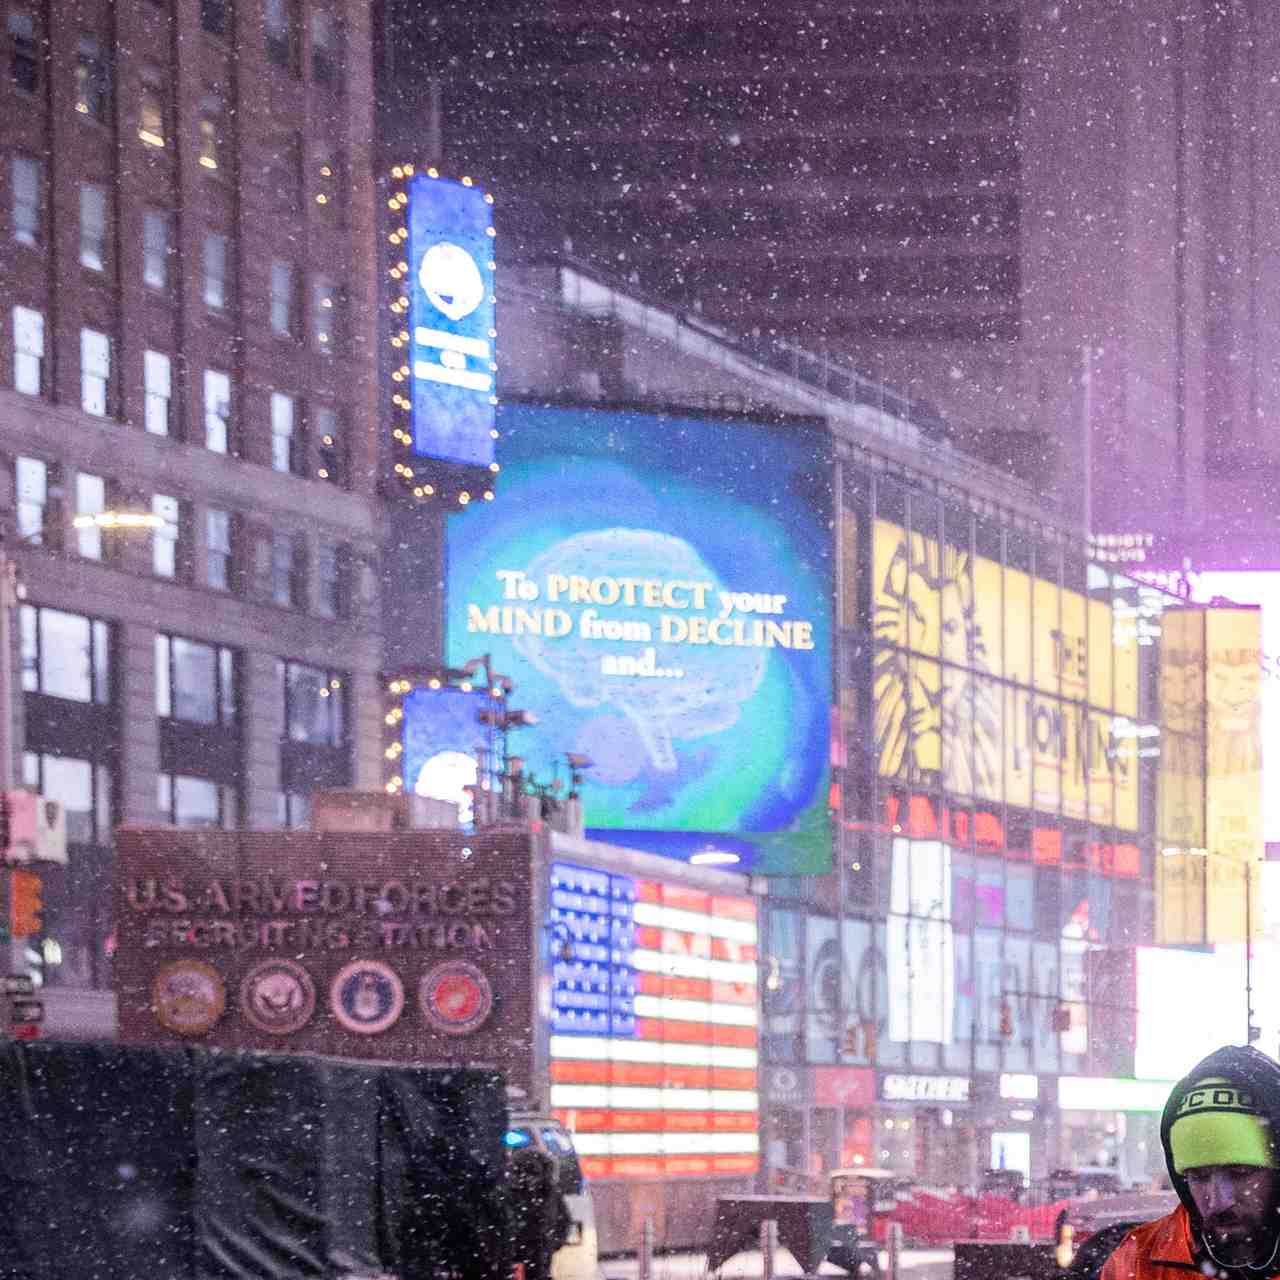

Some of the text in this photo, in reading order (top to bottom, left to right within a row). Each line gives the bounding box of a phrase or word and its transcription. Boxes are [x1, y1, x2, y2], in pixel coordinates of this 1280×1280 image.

[496, 569, 788, 620] To PROTECT your
[467, 603, 815, 651] MIND from DECLINE
